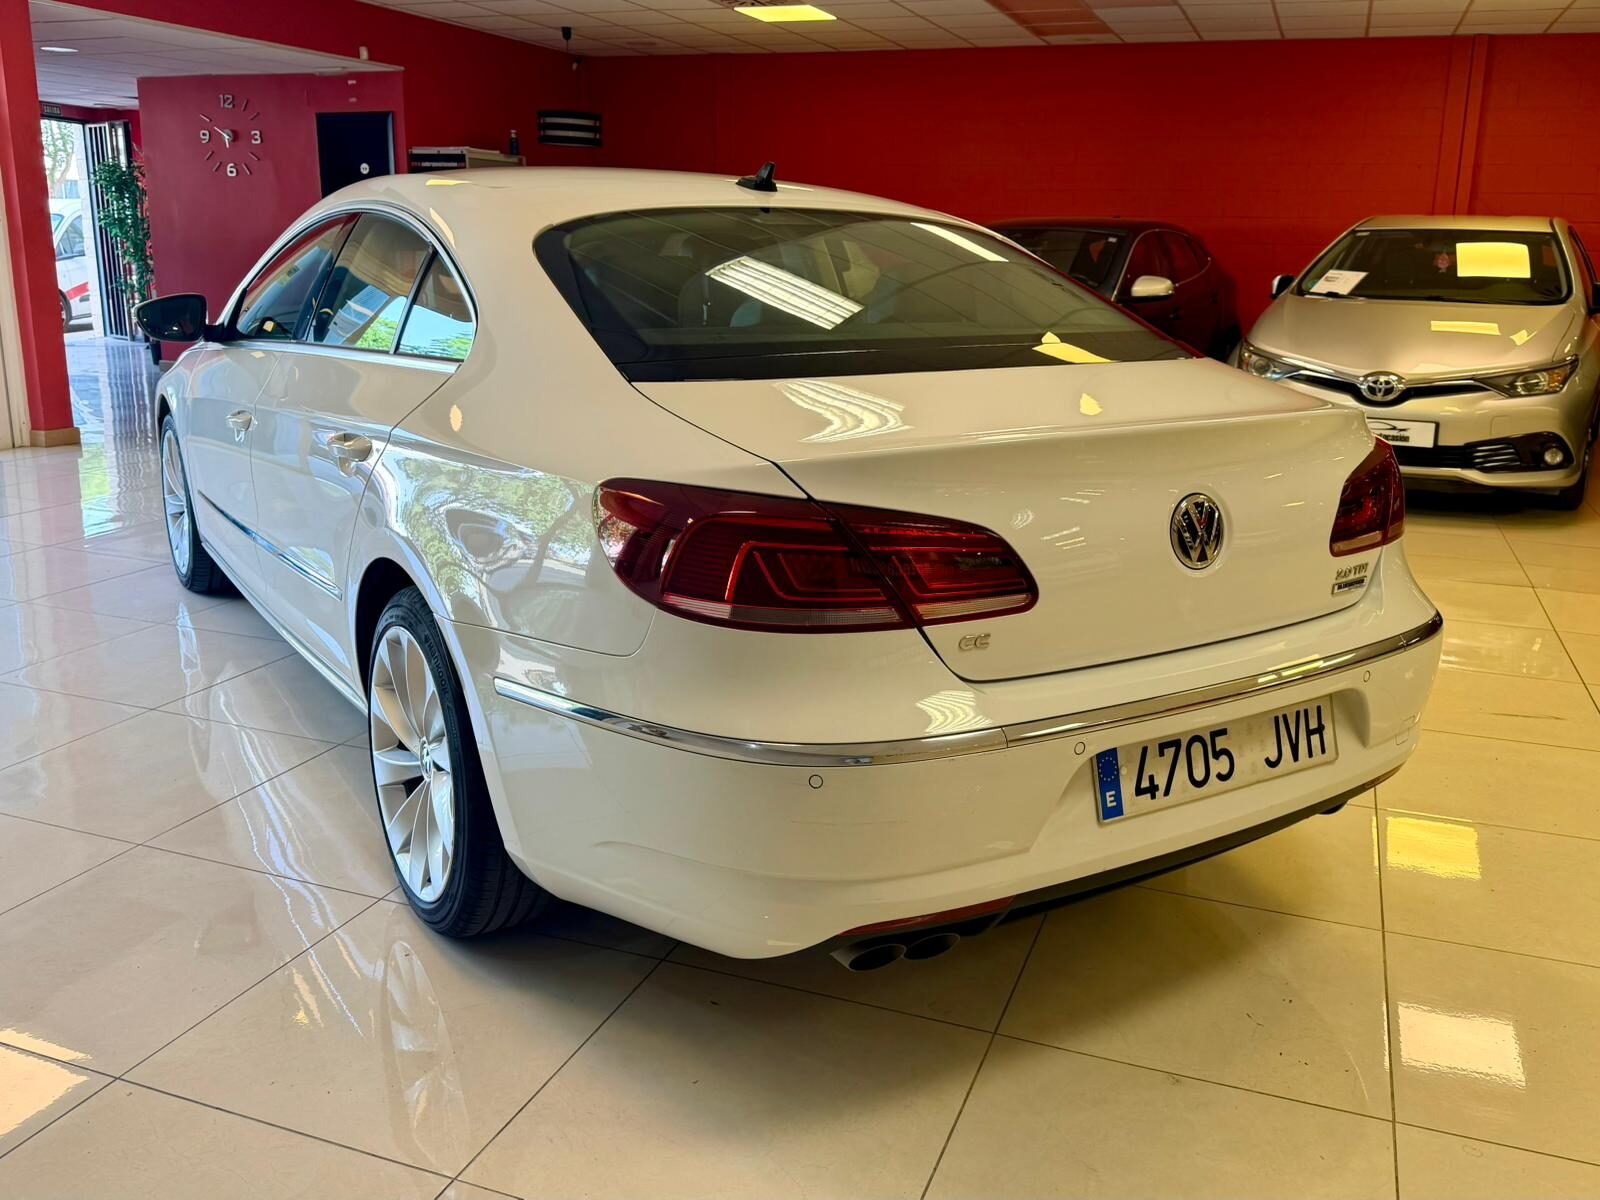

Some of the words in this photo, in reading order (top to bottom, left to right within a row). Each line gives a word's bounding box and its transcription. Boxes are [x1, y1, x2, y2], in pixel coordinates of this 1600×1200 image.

[219, 94, 233, 109] 12
[200, 130, 210, 143] 9
[251, 130, 261, 144] 3
[226, 163, 237, 177] 6
[1173, 496, 1221, 566] VW
[958, 633, 991, 651] CC
[1134, 727, 1235, 800] 4705
[1264, 704, 1326, 769] JVH
[1106, 791, 1117, 807] E
